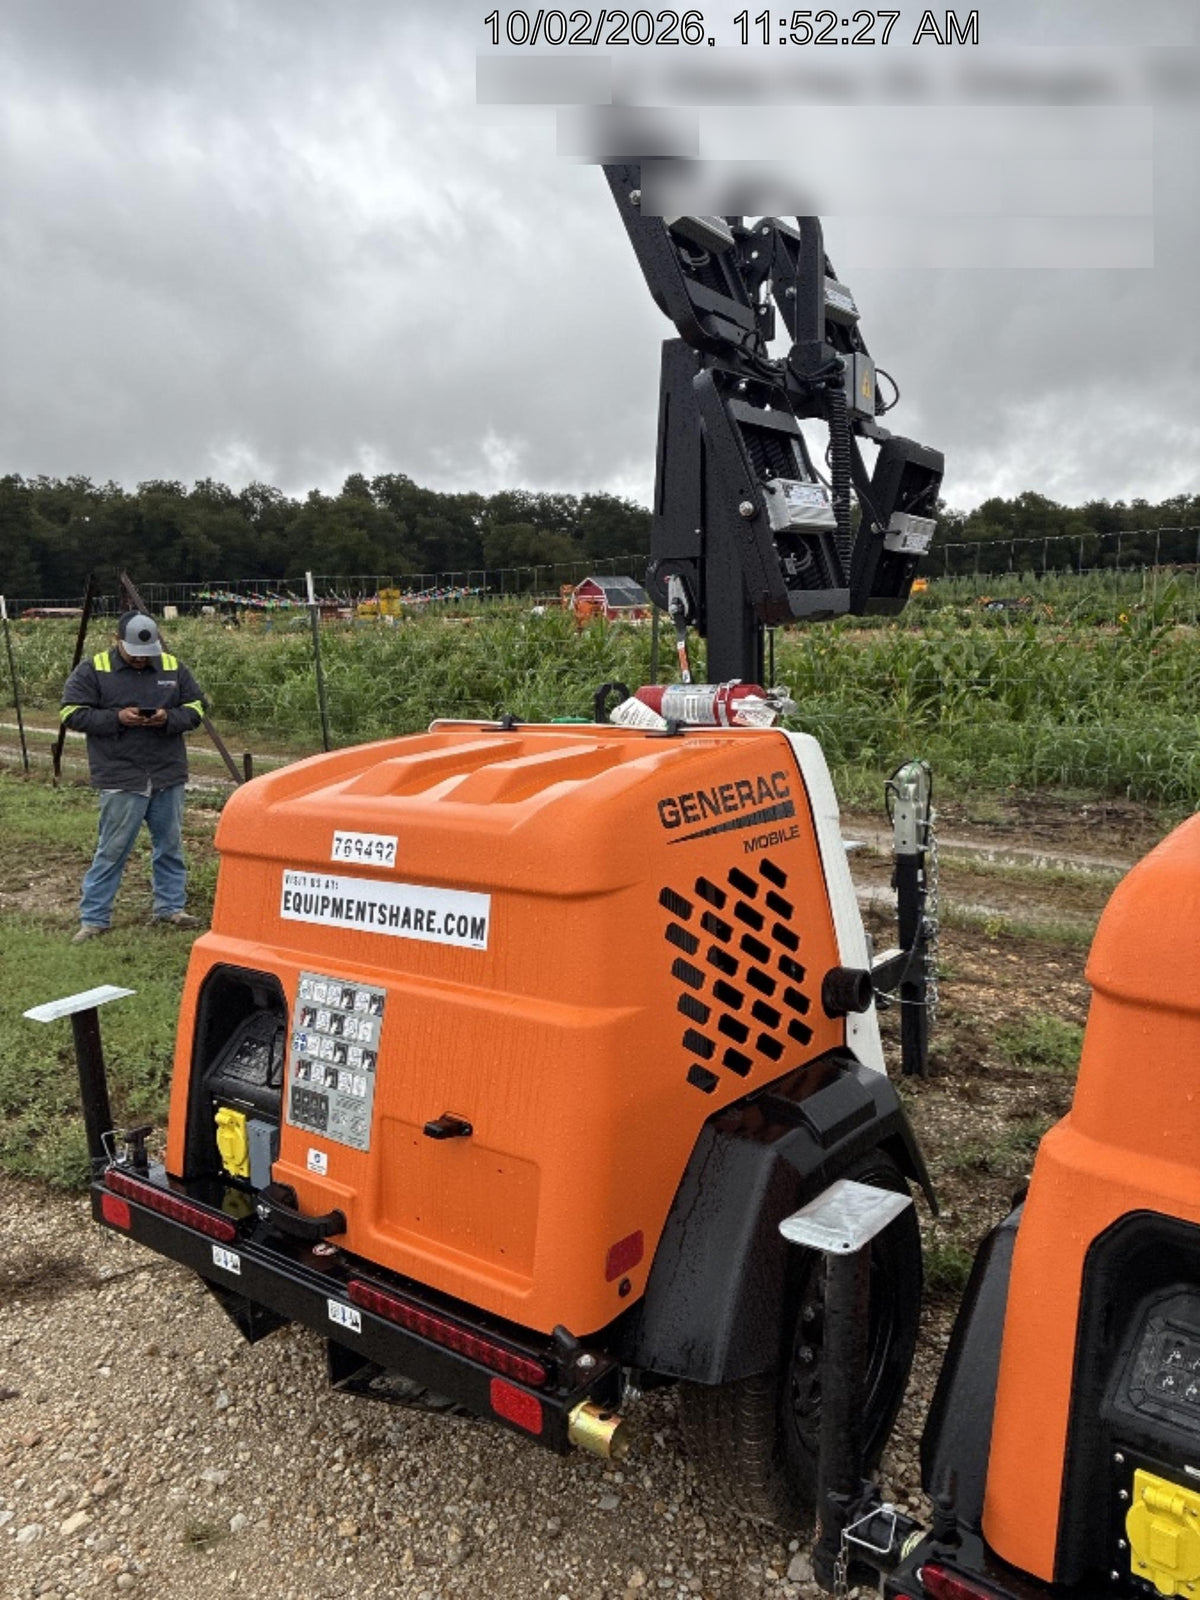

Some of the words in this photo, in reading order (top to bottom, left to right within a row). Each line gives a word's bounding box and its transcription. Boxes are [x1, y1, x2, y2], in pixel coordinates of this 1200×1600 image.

[657, 770, 790, 829] GENERAC
[335, 836, 395, 863] 769492
[743, 825, 800, 853] MOBILE
[284, 889, 486, 941] EQUIPMENTSHARE.COM
